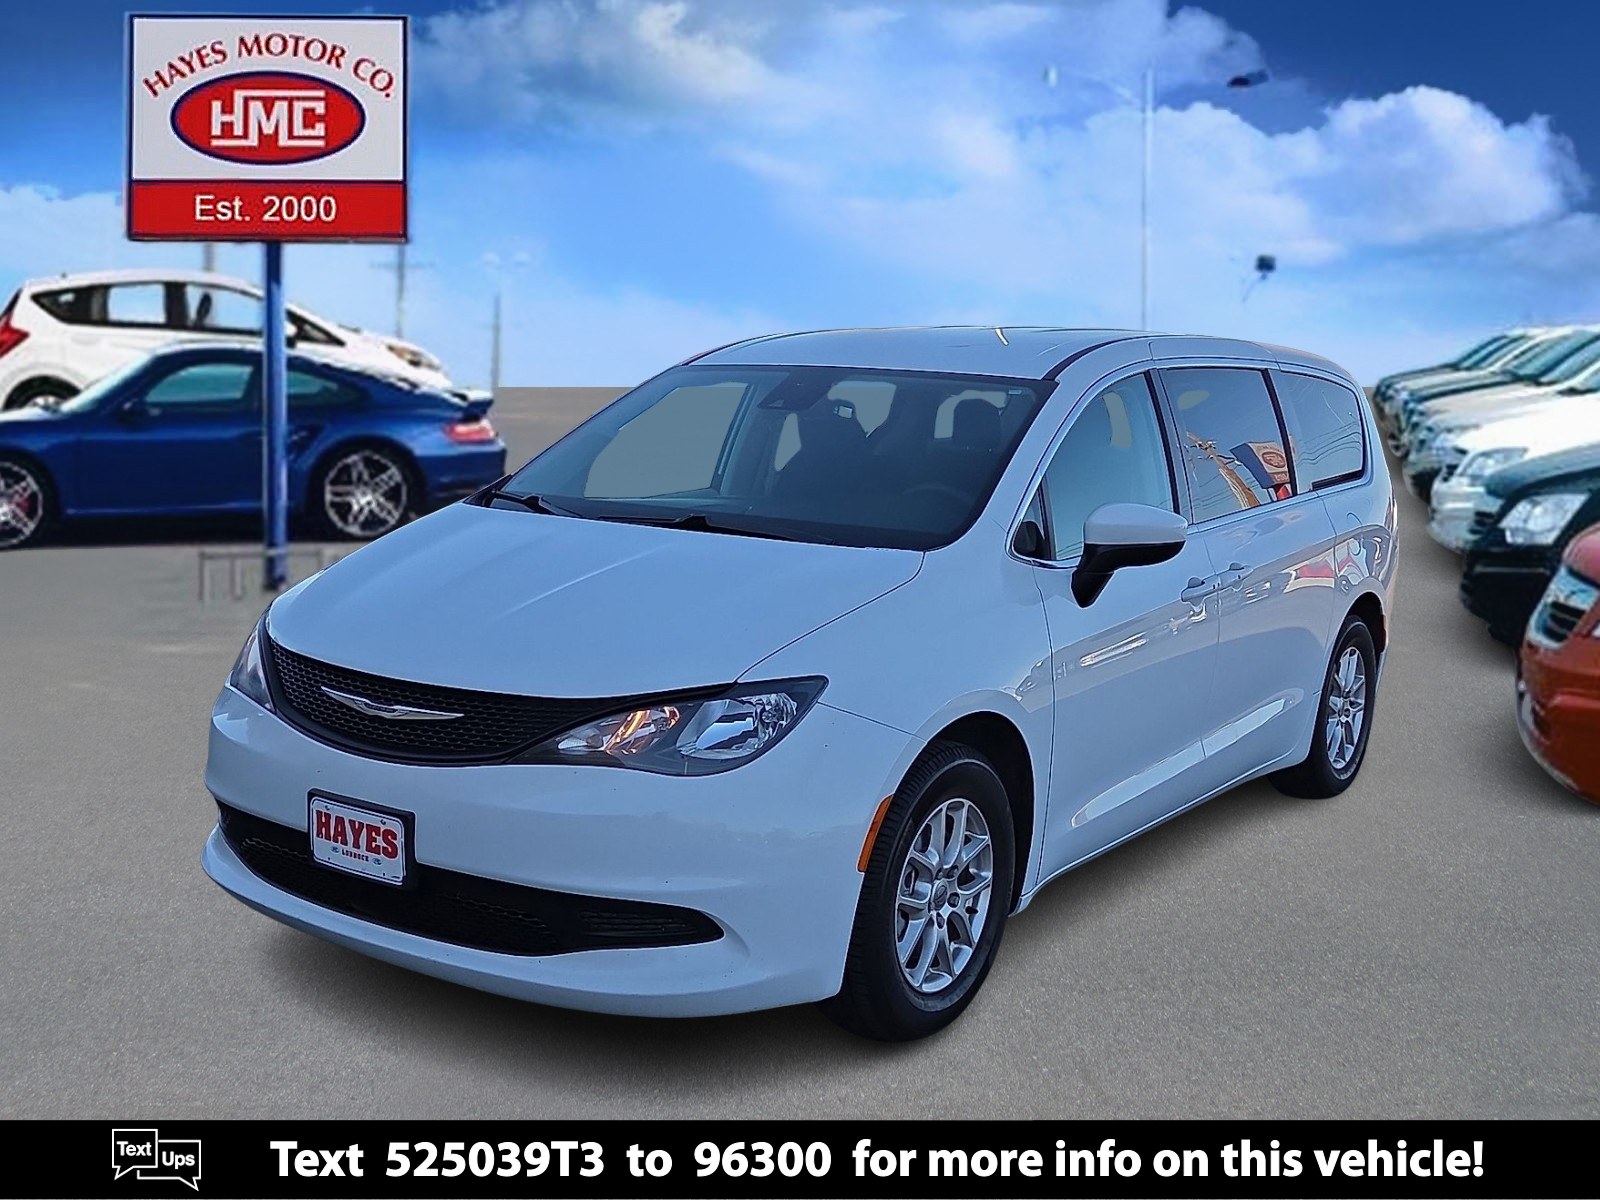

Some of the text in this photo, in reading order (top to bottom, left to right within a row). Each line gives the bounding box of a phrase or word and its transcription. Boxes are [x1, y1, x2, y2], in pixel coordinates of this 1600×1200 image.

[143, 33, 394, 98] HAYES MOTOR CO.
[210, 88, 326, 147] HMC
[195, 194, 337, 222] Est. 2000
[316, 810, 398, 859] HAYES
